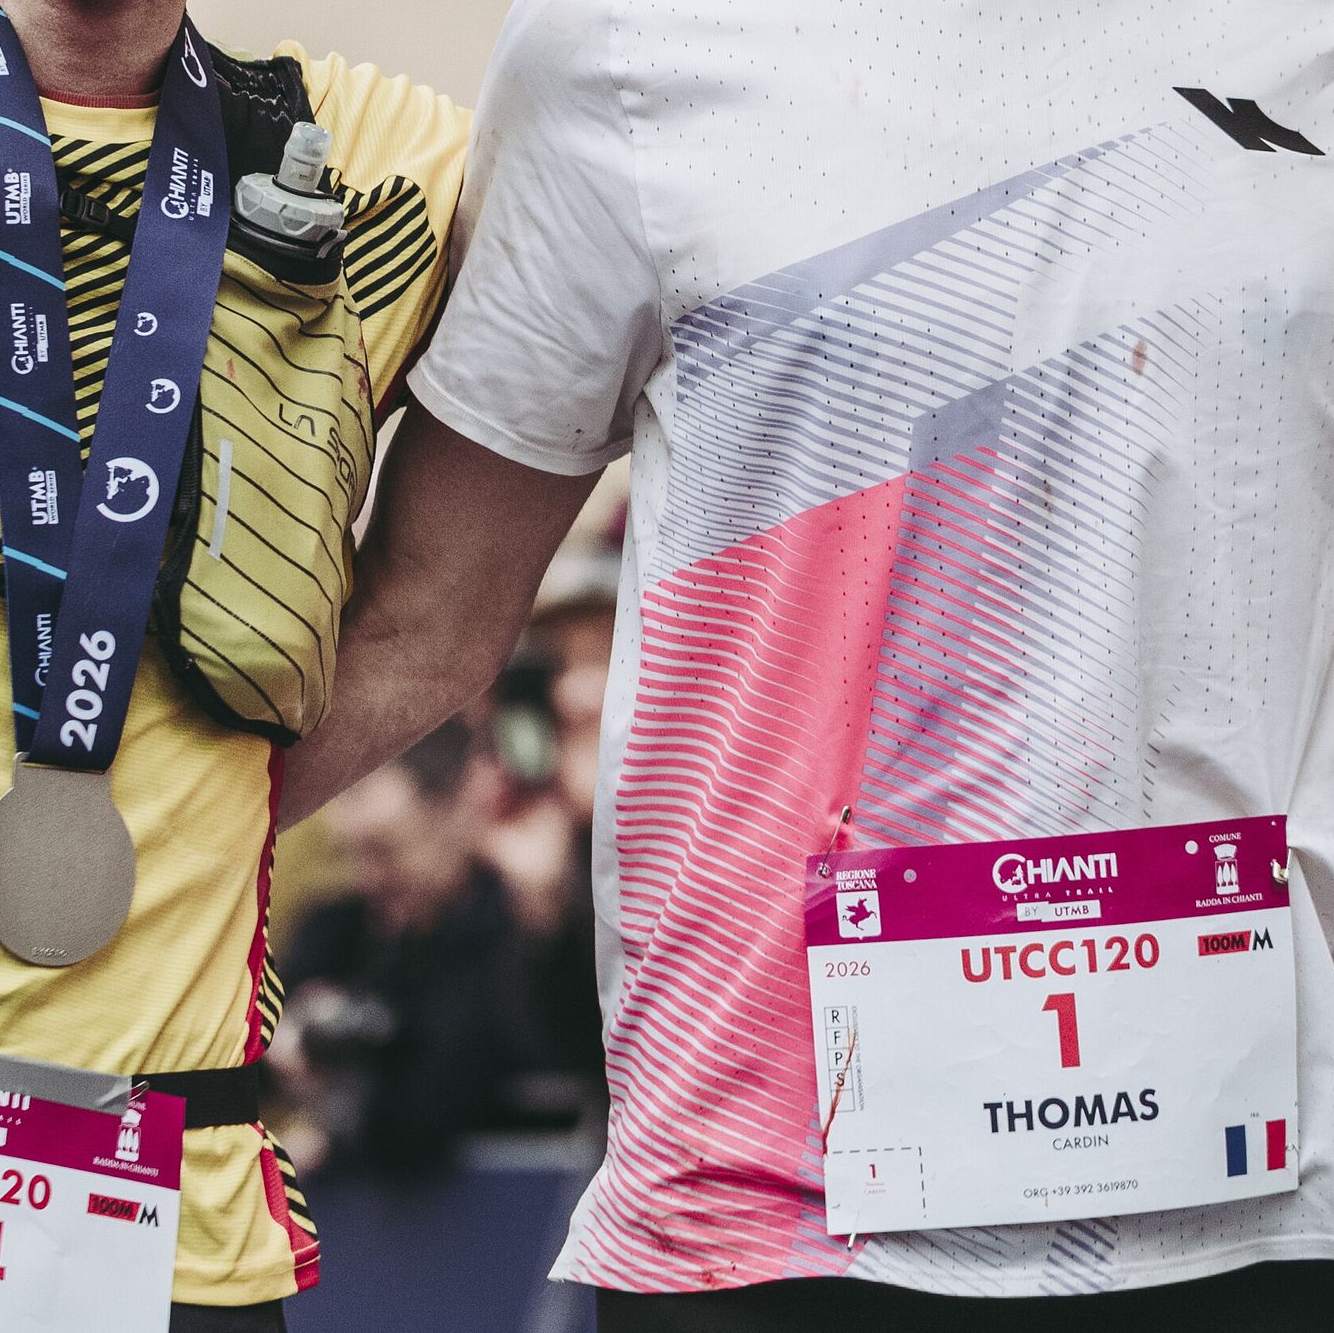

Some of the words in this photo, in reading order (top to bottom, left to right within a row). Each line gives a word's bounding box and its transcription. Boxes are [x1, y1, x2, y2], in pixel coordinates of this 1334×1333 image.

[160, 146, 189, 219] CHIANTI
[4, 168, 21, 225] UTMB
[10, 303, 35, 375] CHIANTI
[28, 466, 49, 526] UTMB
[59, 629, 117, 752] 2026
[1208, 832, 1242, 844] COMUNE
[835, 868, 877, 881] REGIONE
[992, 851, 1119, 895] CHIANTI
[835, 879, 878, 892] TOSCANA
[1001, 891, 1052, 902] ULTRA
[1065, 885, 1115, 898] TRAIL
[1195, 896, 1222, 908] RADDA
[1222, 896, 1232, 905] IN
[1231, 892, 1264, 905] CHIANTI
[1024, 905, 1039, 918] BY
[1054, 904, 1090, 918] UTMB
[1202, 934, 1246, 952] 100M
[960, 932, 1160, 983] UTCC120
[825, 960, 872, 979] 2026
[831, 1009, 841, 1024] R
[833, 1031, 841, 1045] F
[1041, 992, 1081, 1069] 1
[834, 1051, 843, 1066] P
[983, 1088, 1160, 1134] THOMAS
[1052, 1134, 1110, 1151] CARDIN
[869, 1163, 877, 1179] 1
[1023, 1186, 1049, 1199] ORG
[1051, 1184, 1071, 1196] +39
[1074, 1182, 1094, 1195] 392
[1097, 1178, 1139, 1193] 3619870
